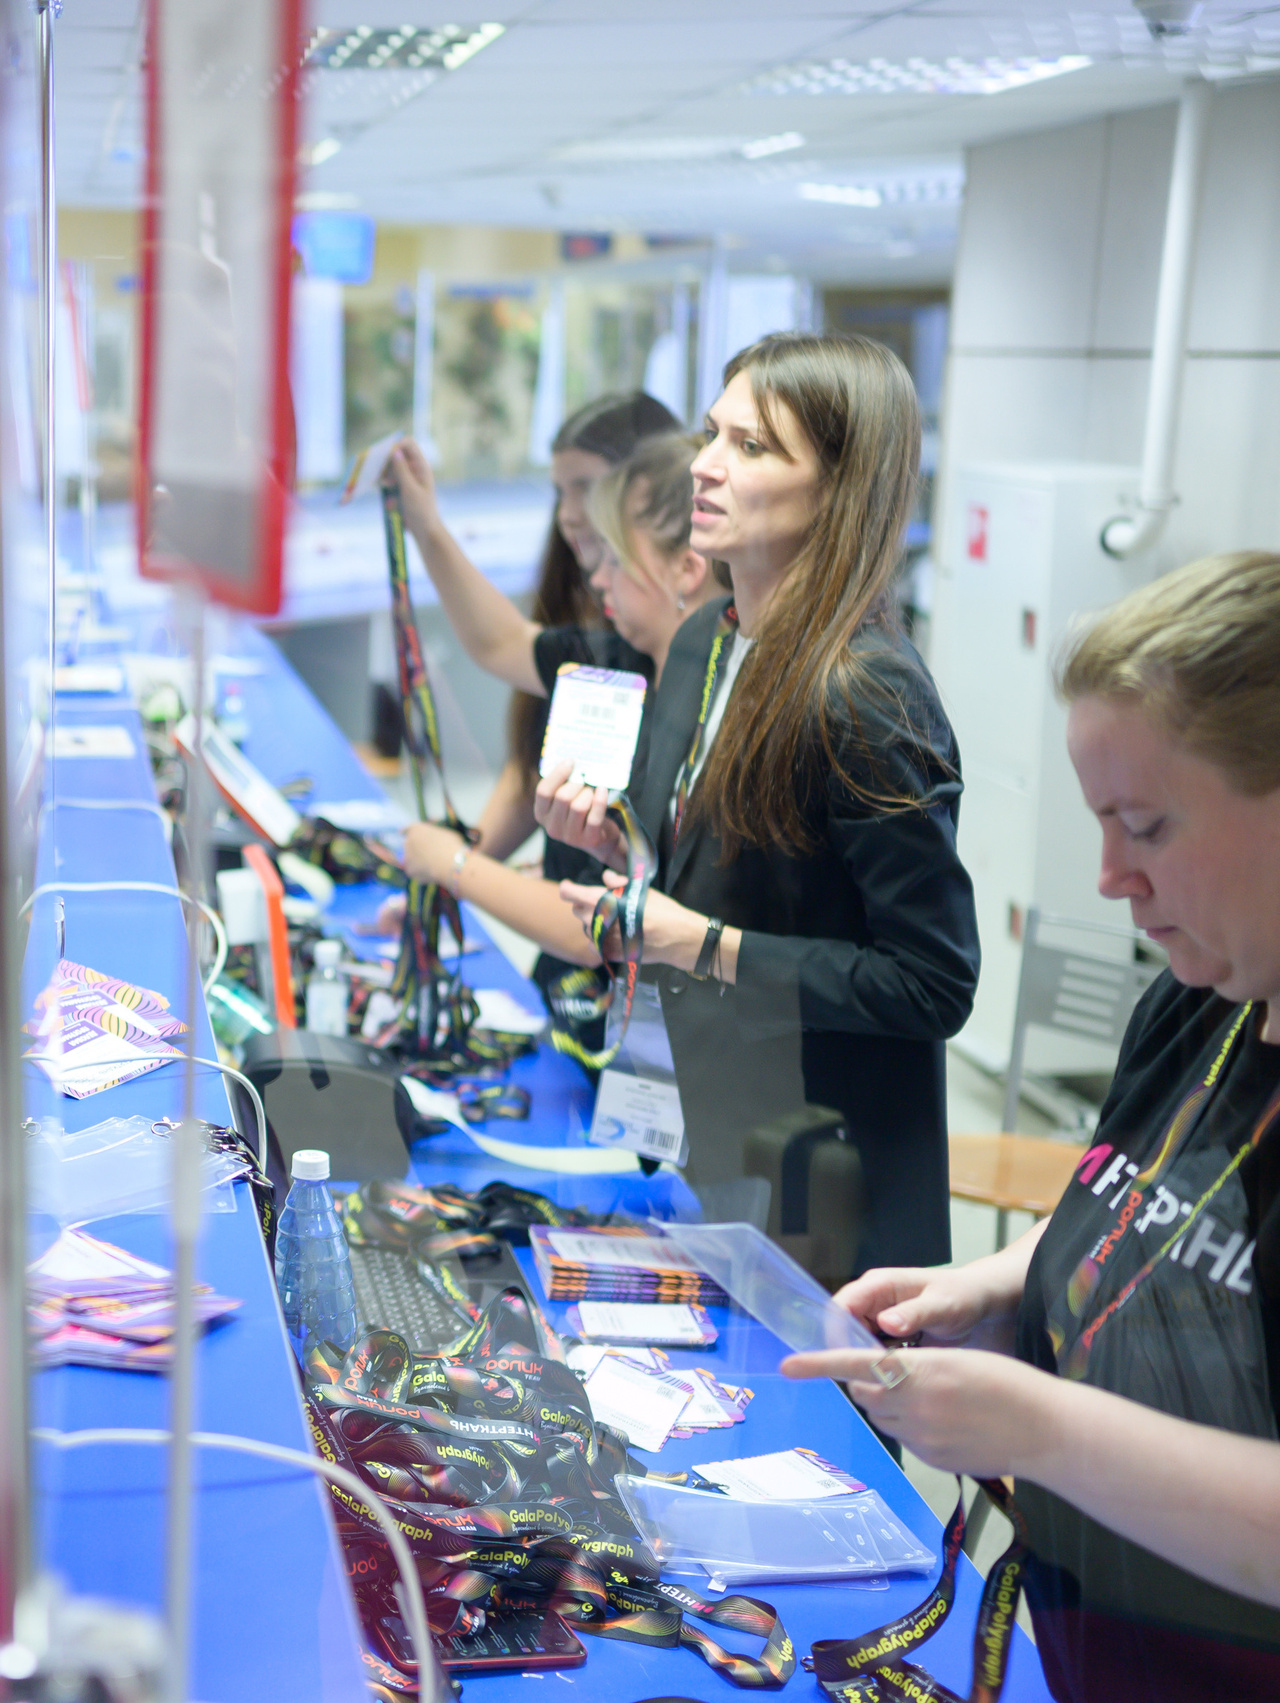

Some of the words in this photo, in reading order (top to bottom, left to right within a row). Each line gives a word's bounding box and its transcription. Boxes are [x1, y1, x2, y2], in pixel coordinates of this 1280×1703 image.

[412, 1370, 448, 1386] Gala
[421, 1513, 475, 1527] олик
[465, 1550, 532, 1570] GalaPoly
[653, 1582, 705, 1613] ИНТЕРТ
[846, 1598, 948, 1670] GalaPolygraph
